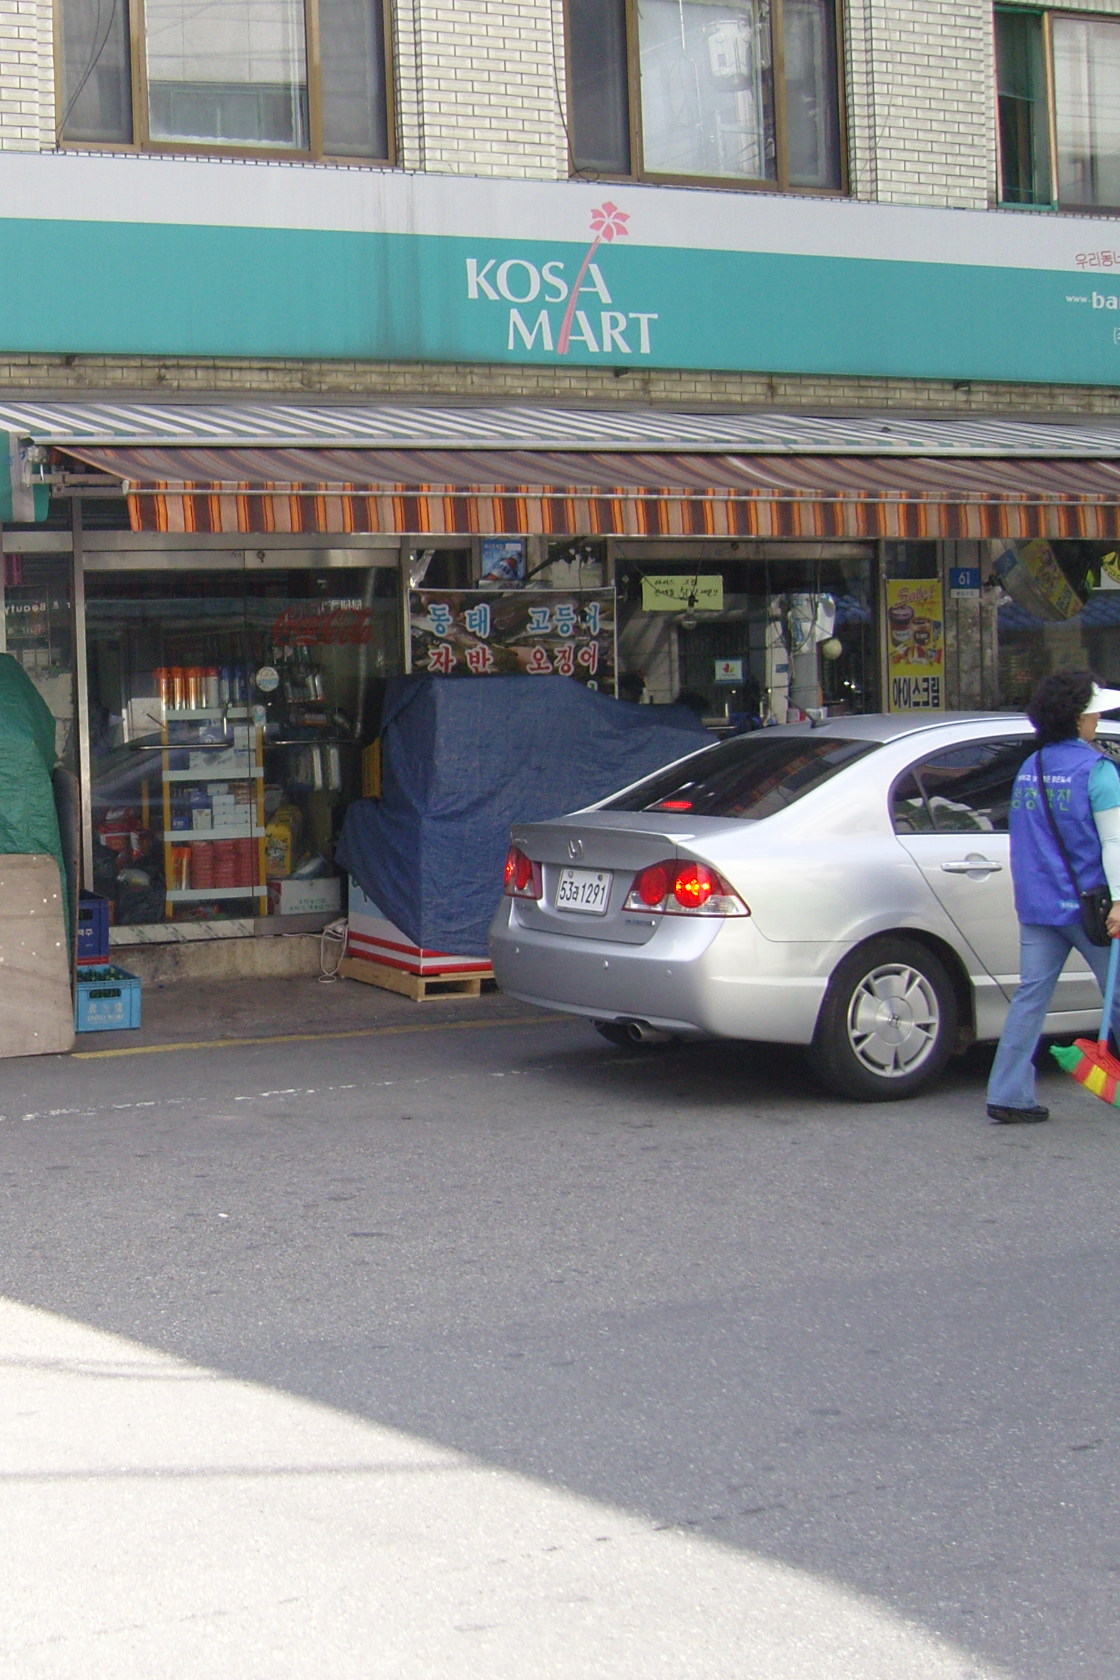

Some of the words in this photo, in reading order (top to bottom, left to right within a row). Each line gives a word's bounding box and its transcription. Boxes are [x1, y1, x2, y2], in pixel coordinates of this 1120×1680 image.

[465, 258, 612, 303] KOSA
[1065, 291, 1120, 309] www.ba
[507, 308, 658, 354] MART
[958, 571, 971, 585] 61
[528, 641, 599, 676] 오징어
[892, 676, 940, 708] 아이스크림
